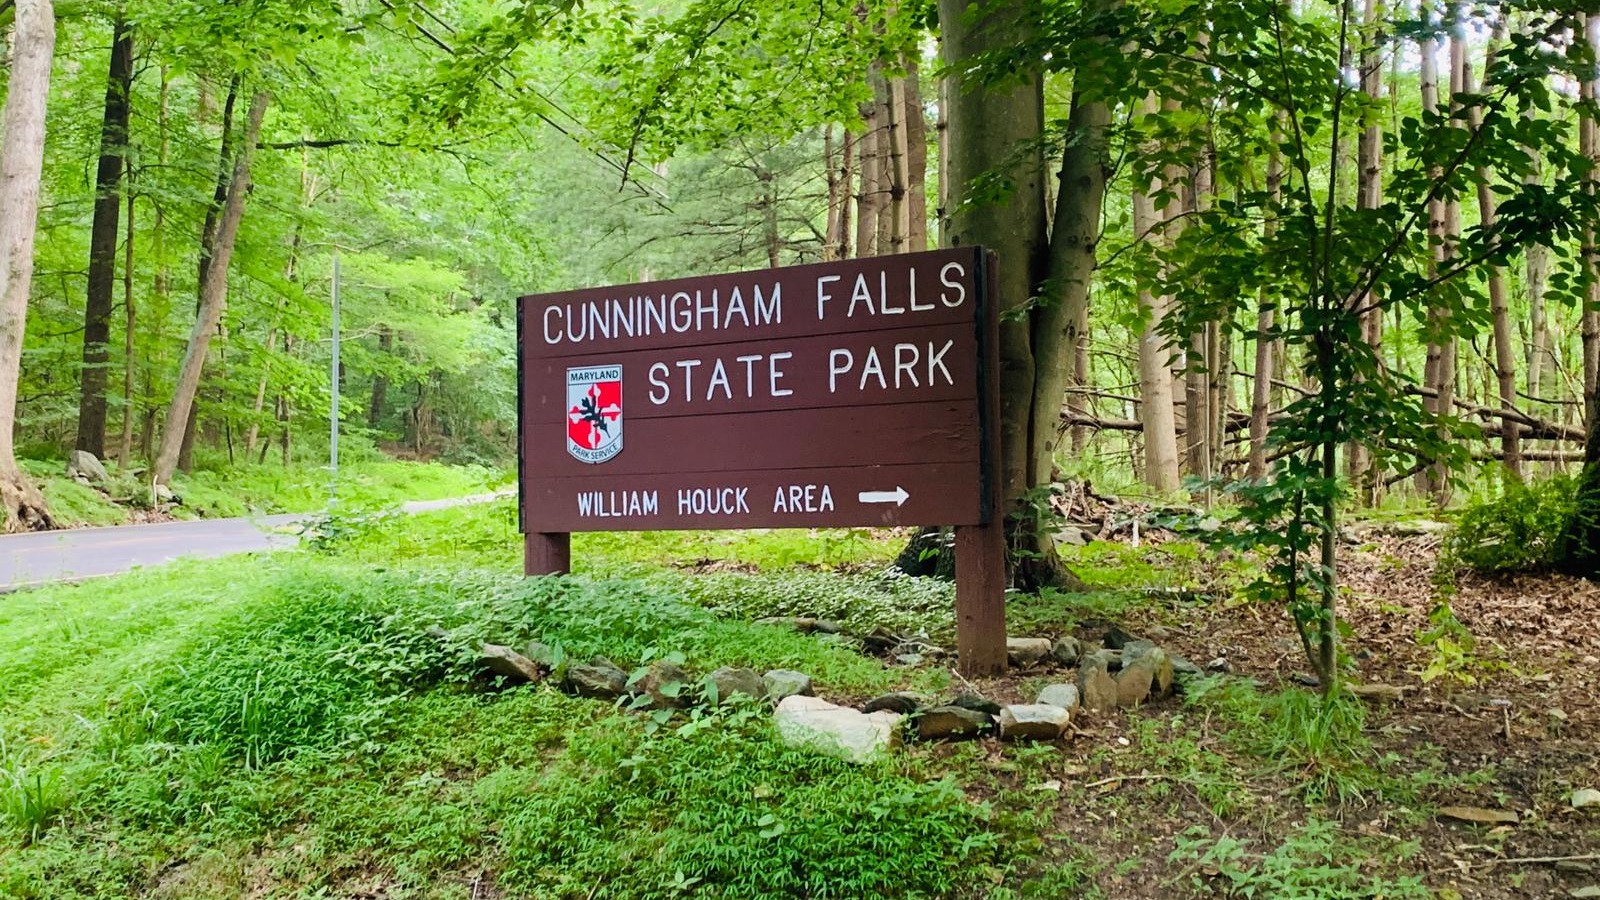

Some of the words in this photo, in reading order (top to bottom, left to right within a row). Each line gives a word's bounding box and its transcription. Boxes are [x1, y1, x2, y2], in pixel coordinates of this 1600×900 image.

[543, 282, 782, 345] CUNNINGHAM
[817, 261, 967, 320] FALLS
[570, 370, 619, 382] MARYLAND
[648, 351, 793, 405] STATE
[829, 338, 955, 393] PARK
[572, 445, 592, 458] PARK
[591, 442, 618, 460] SERVICE
[577, 489, 659, 518] WILLIAM
[677, 486, 750, 515] HOUCK
[772, 484, 835, 513] AREA
